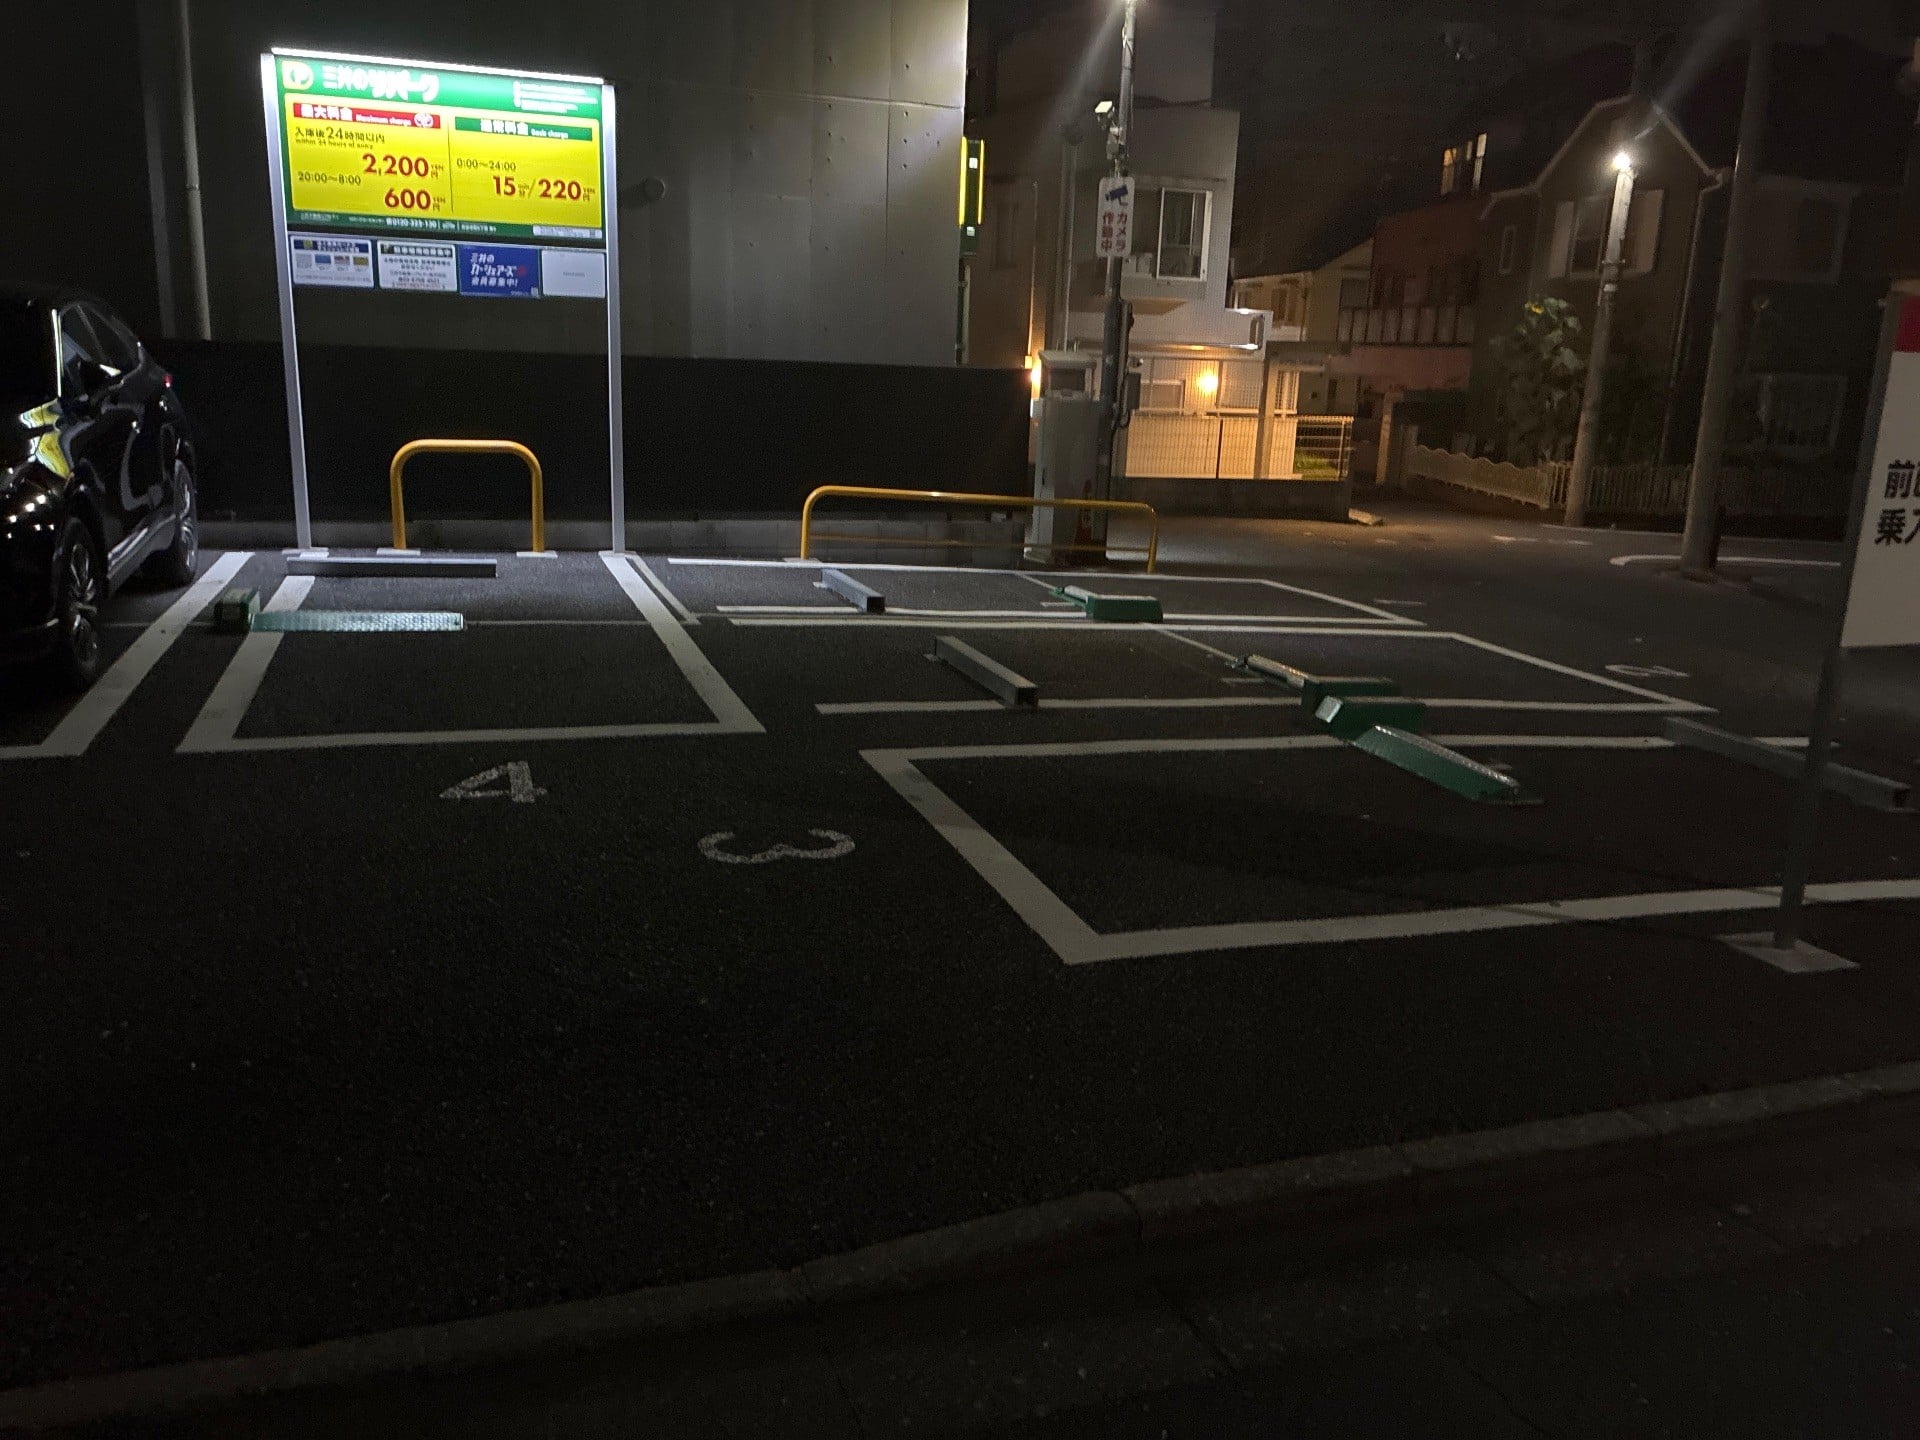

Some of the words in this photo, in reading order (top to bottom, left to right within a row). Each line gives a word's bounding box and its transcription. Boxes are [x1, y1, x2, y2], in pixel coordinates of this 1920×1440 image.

[362, 153, 430, 178] 2,200
[384, 188, 431, 210] 600
[493, 175, 516, 196] 15
[538, 178, 582, 201] 220
[1884, 459, 1920, 498] 前
[439, 761, 549, 803] 4
[698, 827, 856, 865] 3
